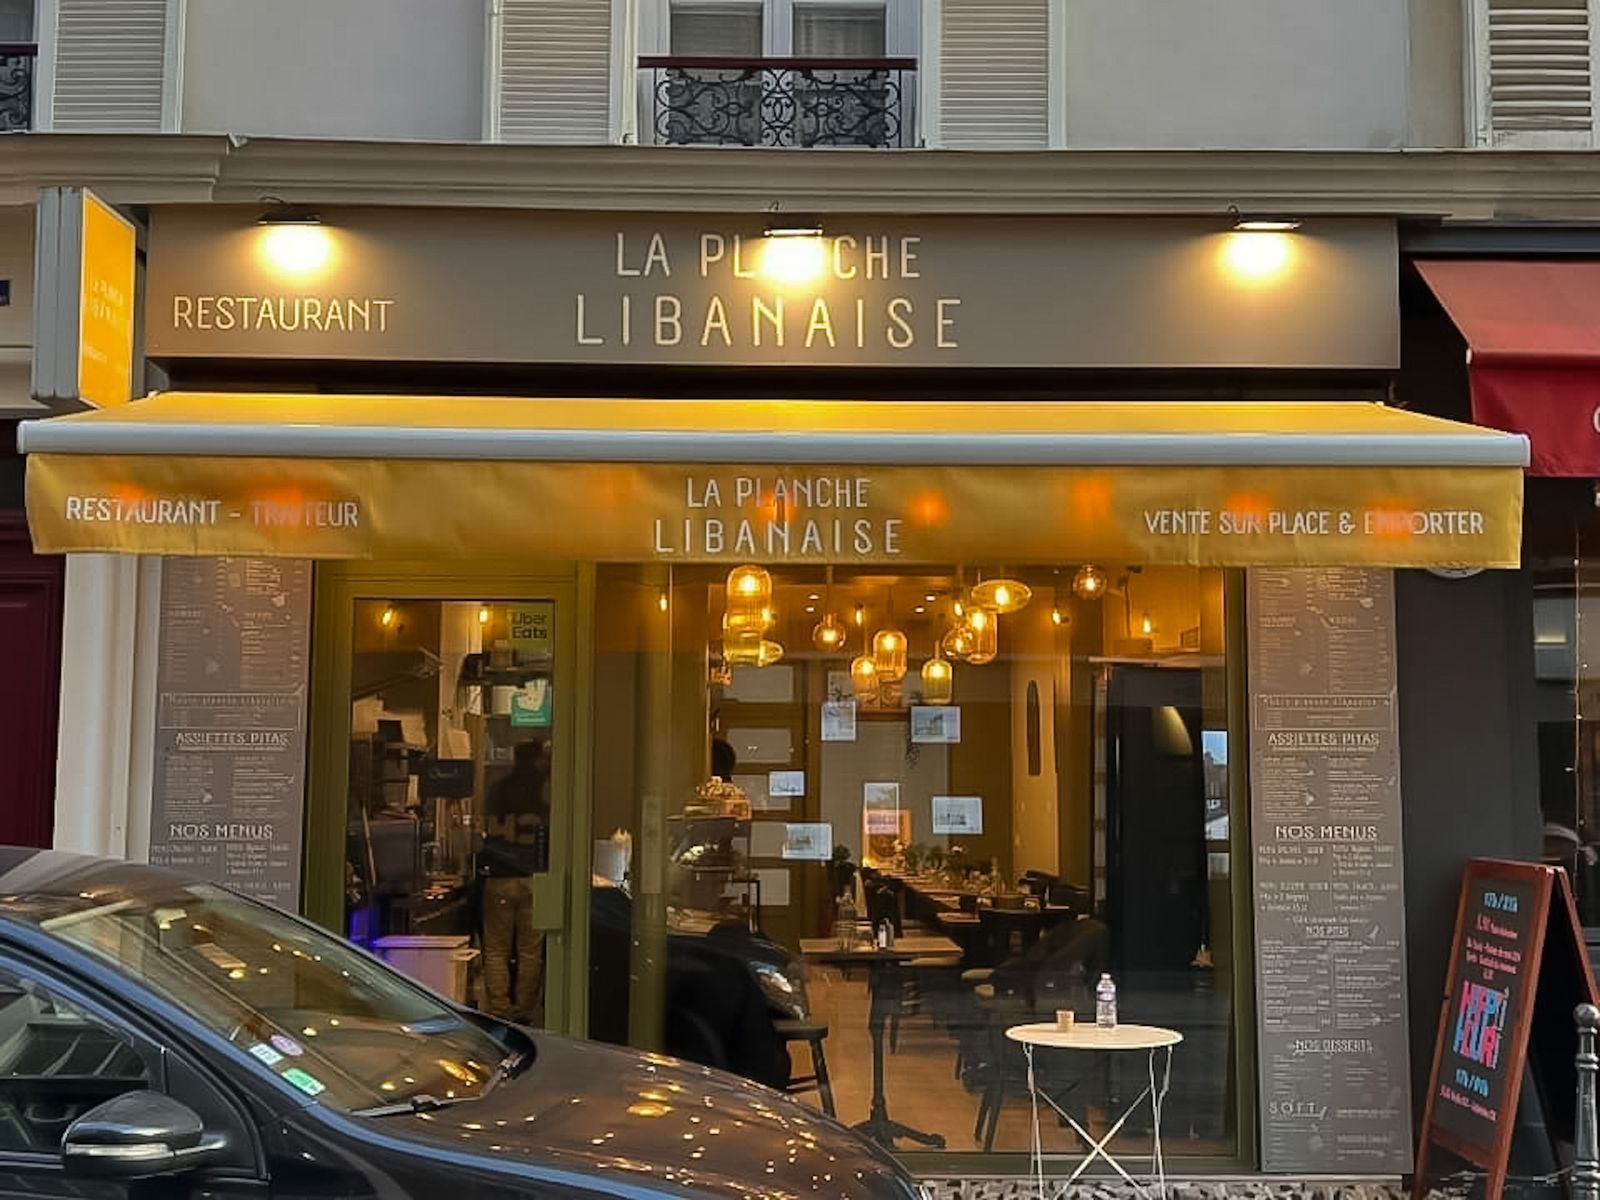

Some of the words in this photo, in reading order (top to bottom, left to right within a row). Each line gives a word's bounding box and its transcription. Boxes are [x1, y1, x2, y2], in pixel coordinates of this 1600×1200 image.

[615, 231, 671, 278] LA
[699, 232, 922, 280] PLCHE
[173, 295, 394, 332] RESTAURANT
[576, 293, 962, 349] LIBANAISE
[686, 477, 721, 508] LA
[735, 477, 872, 509] PLANCHE
[65, 495, 222, 527] RESTAURANT
[1144, 510, 1212, 535] VENTE
[1218, 510, 1263, 536] SUR
[1268, 510, 1330, 536] PLACE
[1338, 511, 1356, 536] &
[1363, 510, 1485, 536] EORTER
[654, 518, 903, 555] LIBANAISE
[512, 611, 547, 625] Uber
[512, 625, 548, 639] Eats
[169, 824, 210, 838] NOS
[215, 824, 274, 840] MENUS
[1275, 825, 1316, 840] NOS
[1321, 825, 1378, 841] MENUS
